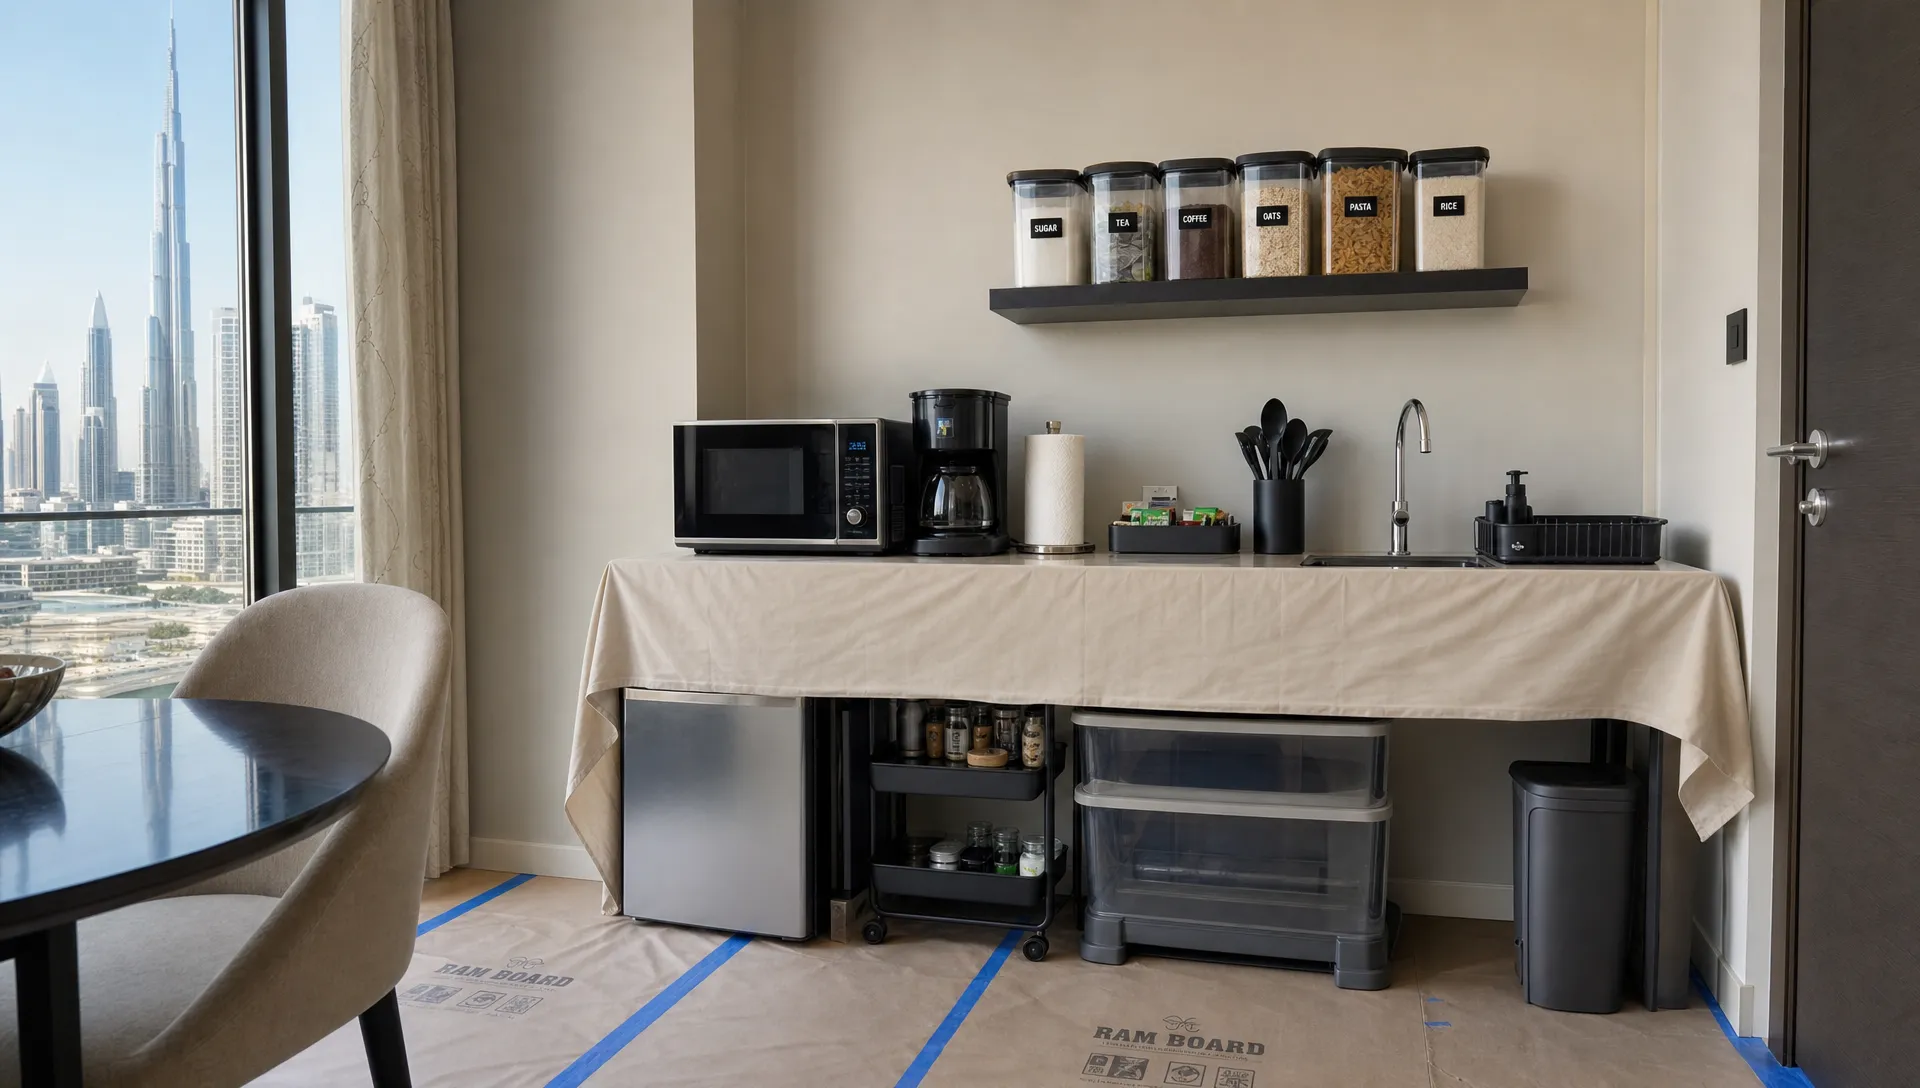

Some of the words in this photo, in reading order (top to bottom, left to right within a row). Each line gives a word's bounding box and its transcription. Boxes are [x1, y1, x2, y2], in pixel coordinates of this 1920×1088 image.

[1349, 202, 1372, 212] PASTA
[1440, 201, 1458, 211] RICE
[1182, 214, 1208, 224] COFFEE
[1262, 212, 1282, 221] OATS
[1115, 218, 1130, 227] TEA
[1034, 223, 1058, 233] SUGAR
[434, 963, 492, 978] RAM
[490, 969, 575, 988] BOARD
[1093, 1026, 1158, 1045] RAM
[1166, 1033, 1265, 1056] BOARD
